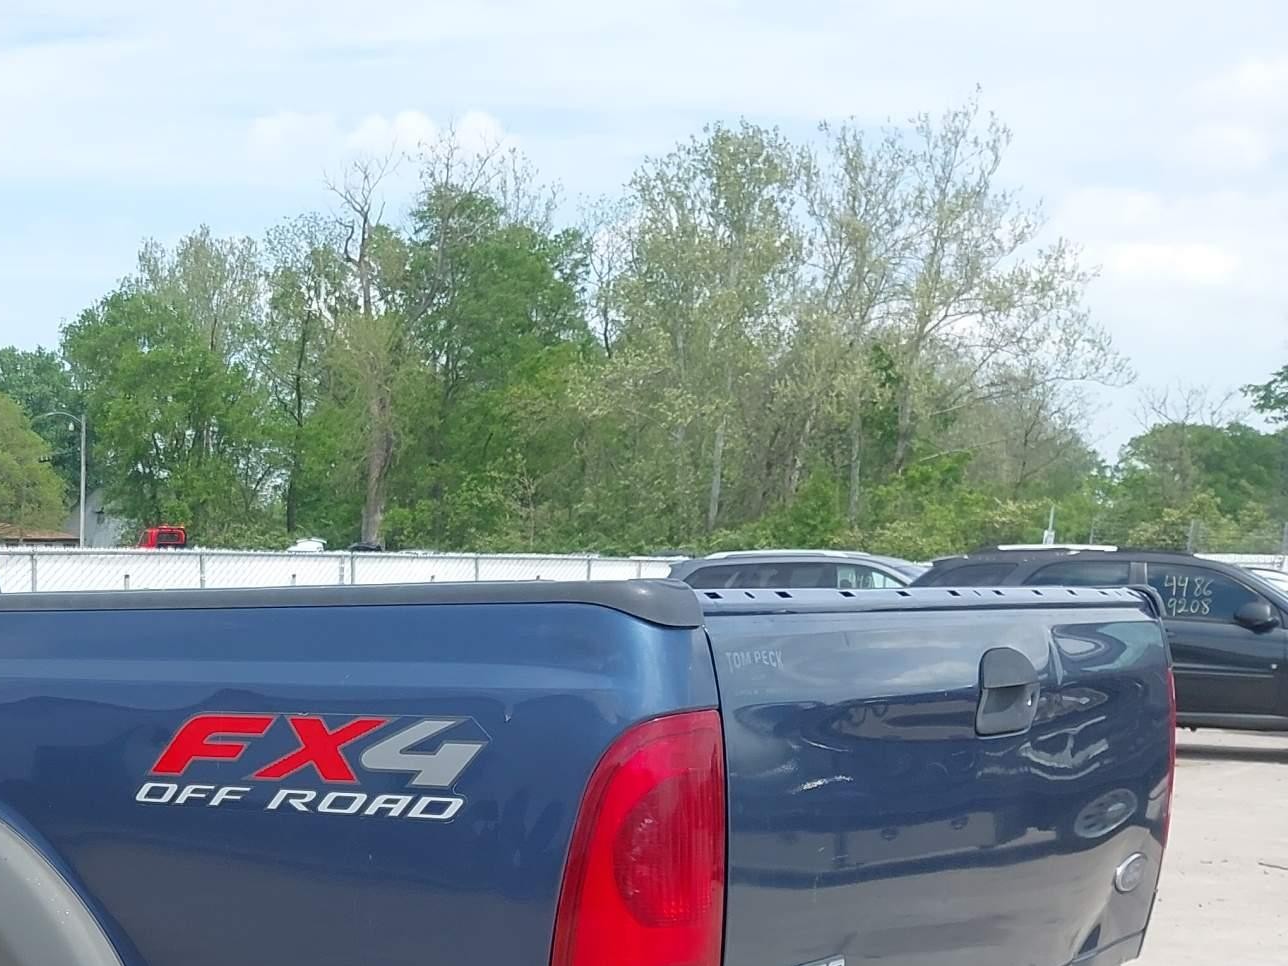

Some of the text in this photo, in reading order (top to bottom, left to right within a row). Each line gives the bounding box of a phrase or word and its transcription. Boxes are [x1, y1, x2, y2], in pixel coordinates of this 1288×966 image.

[1167, 598, 1212, 616] 9208
[725, 650, 784, 673] TOM PECK
[150, 713, 485, 787] FX4
[135, 782, 464, 820] OFF ROAD
